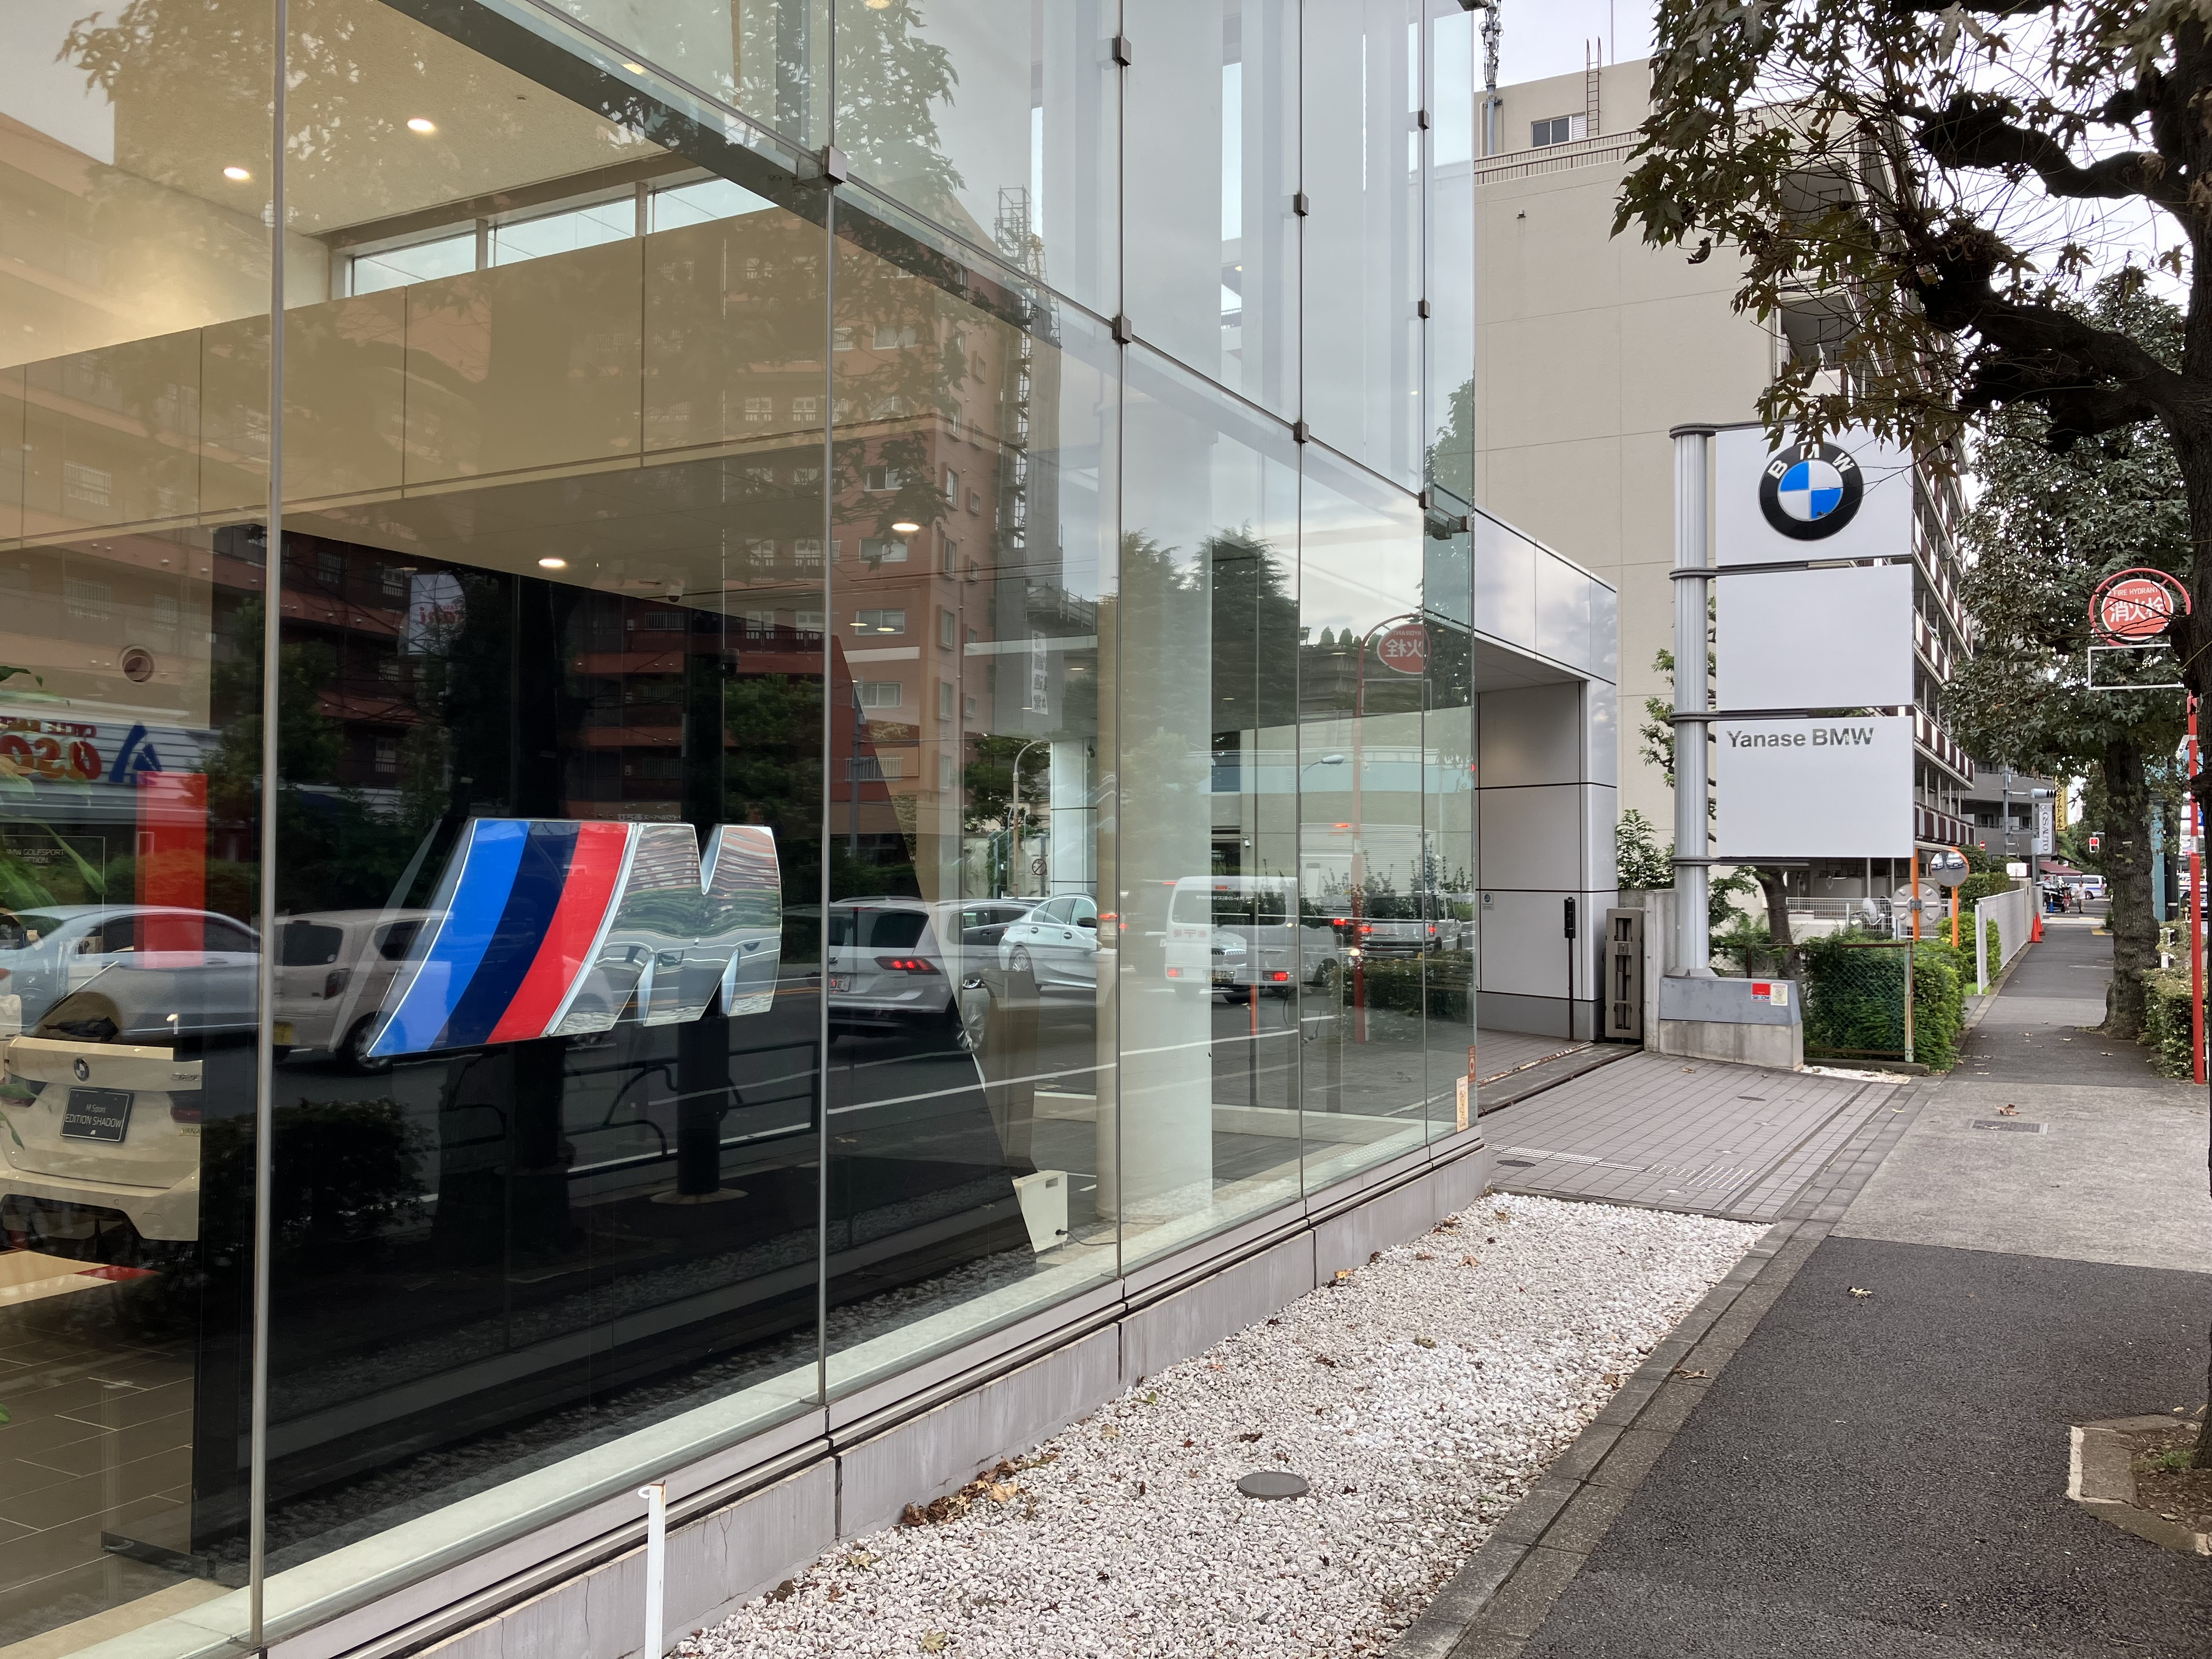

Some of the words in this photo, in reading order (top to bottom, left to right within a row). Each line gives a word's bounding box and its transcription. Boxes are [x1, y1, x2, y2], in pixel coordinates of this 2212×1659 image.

[1770, 444, 1855, 479] BMW
[2129, 586, 2158, 596] HYDRANT
[2109, 596, 2166, 622] 消火栓
[1726, 730, 1806, 748] Yanase
[1812, 727, 1875, 746] BMW
[92, 1104, 106, 1114] Sport
[65, 1113, 92, 1124] EDITION
[93, 1115, 123, 1128] SHADOW
